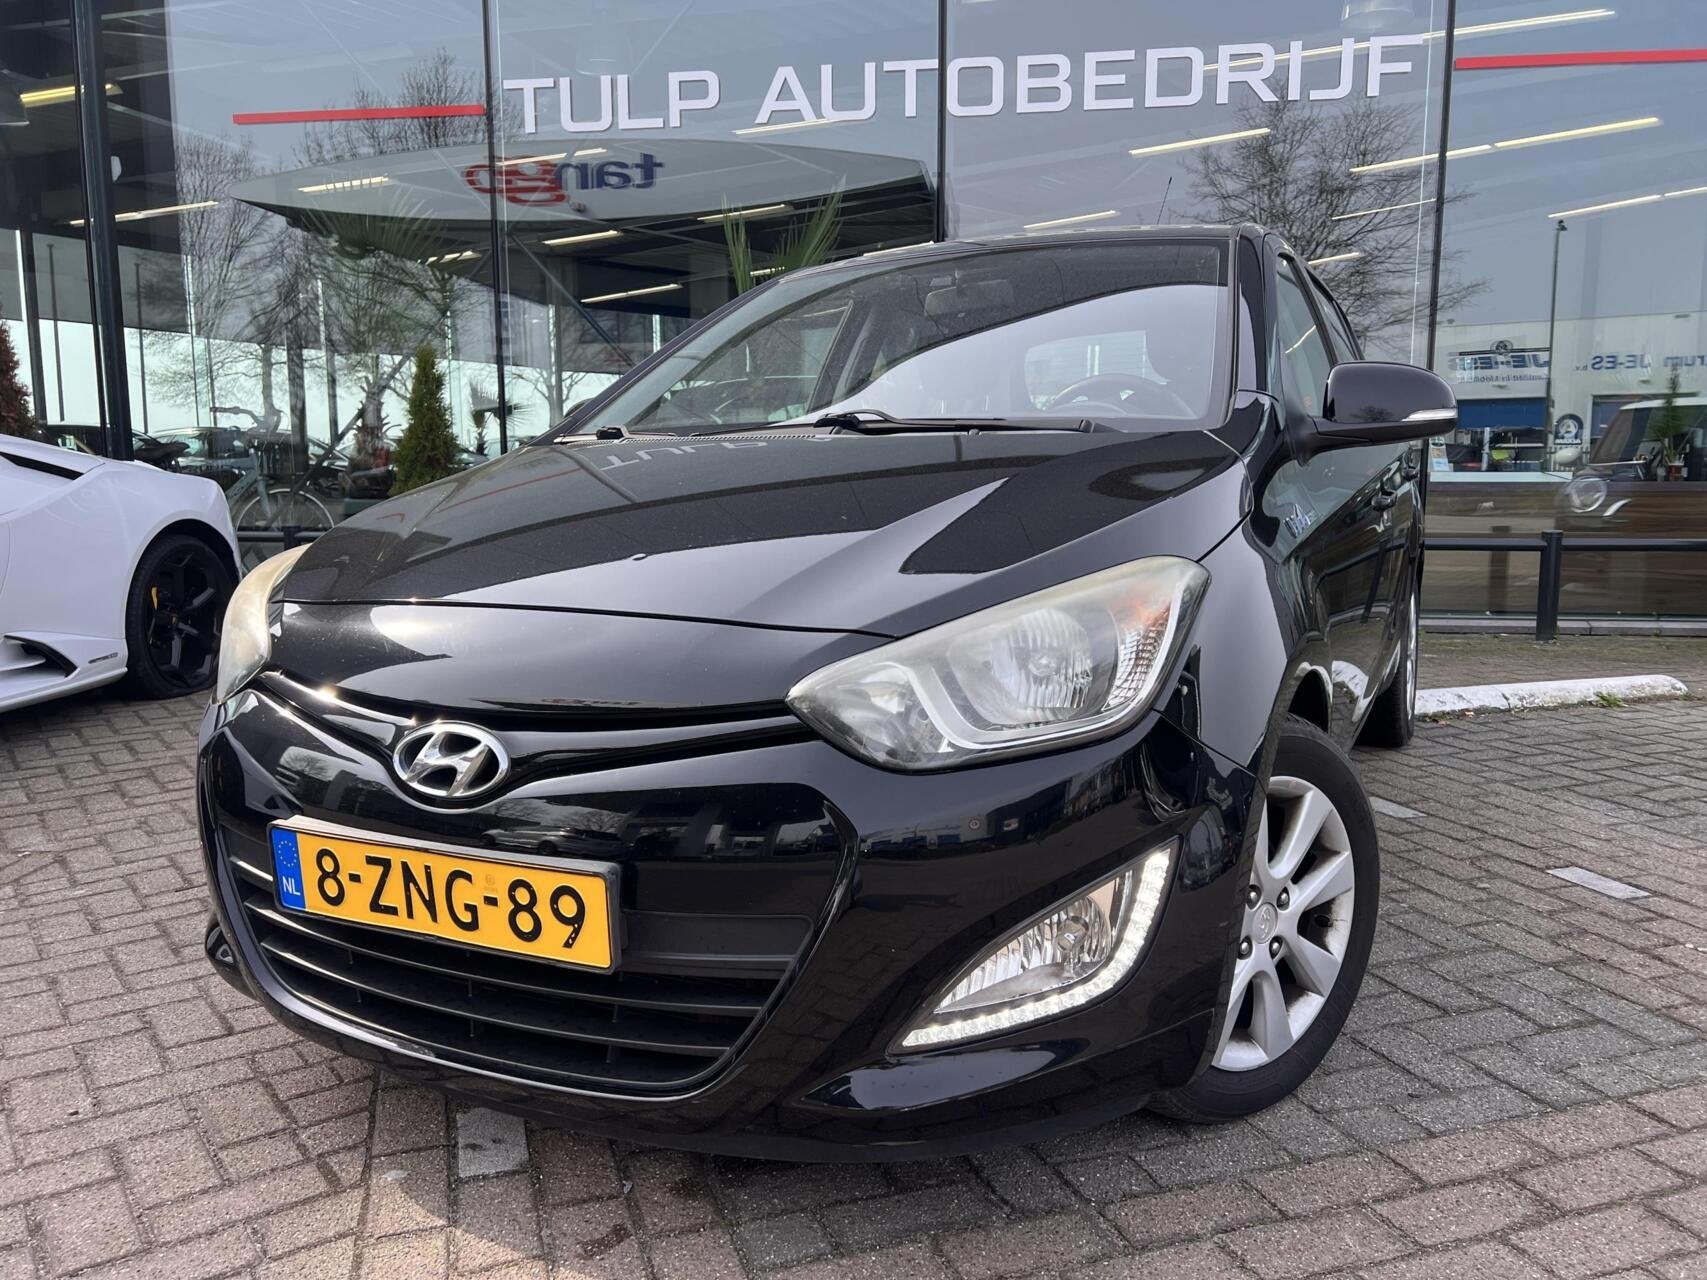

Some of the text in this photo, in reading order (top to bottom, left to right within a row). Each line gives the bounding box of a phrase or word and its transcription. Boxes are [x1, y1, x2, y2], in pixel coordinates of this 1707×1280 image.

[503, 34, 1425, 133] TULP AUTOBEDRIJF
[283, 875, 301, 896] NL
[315, 848, 586, 949] 8-ZNG-89
